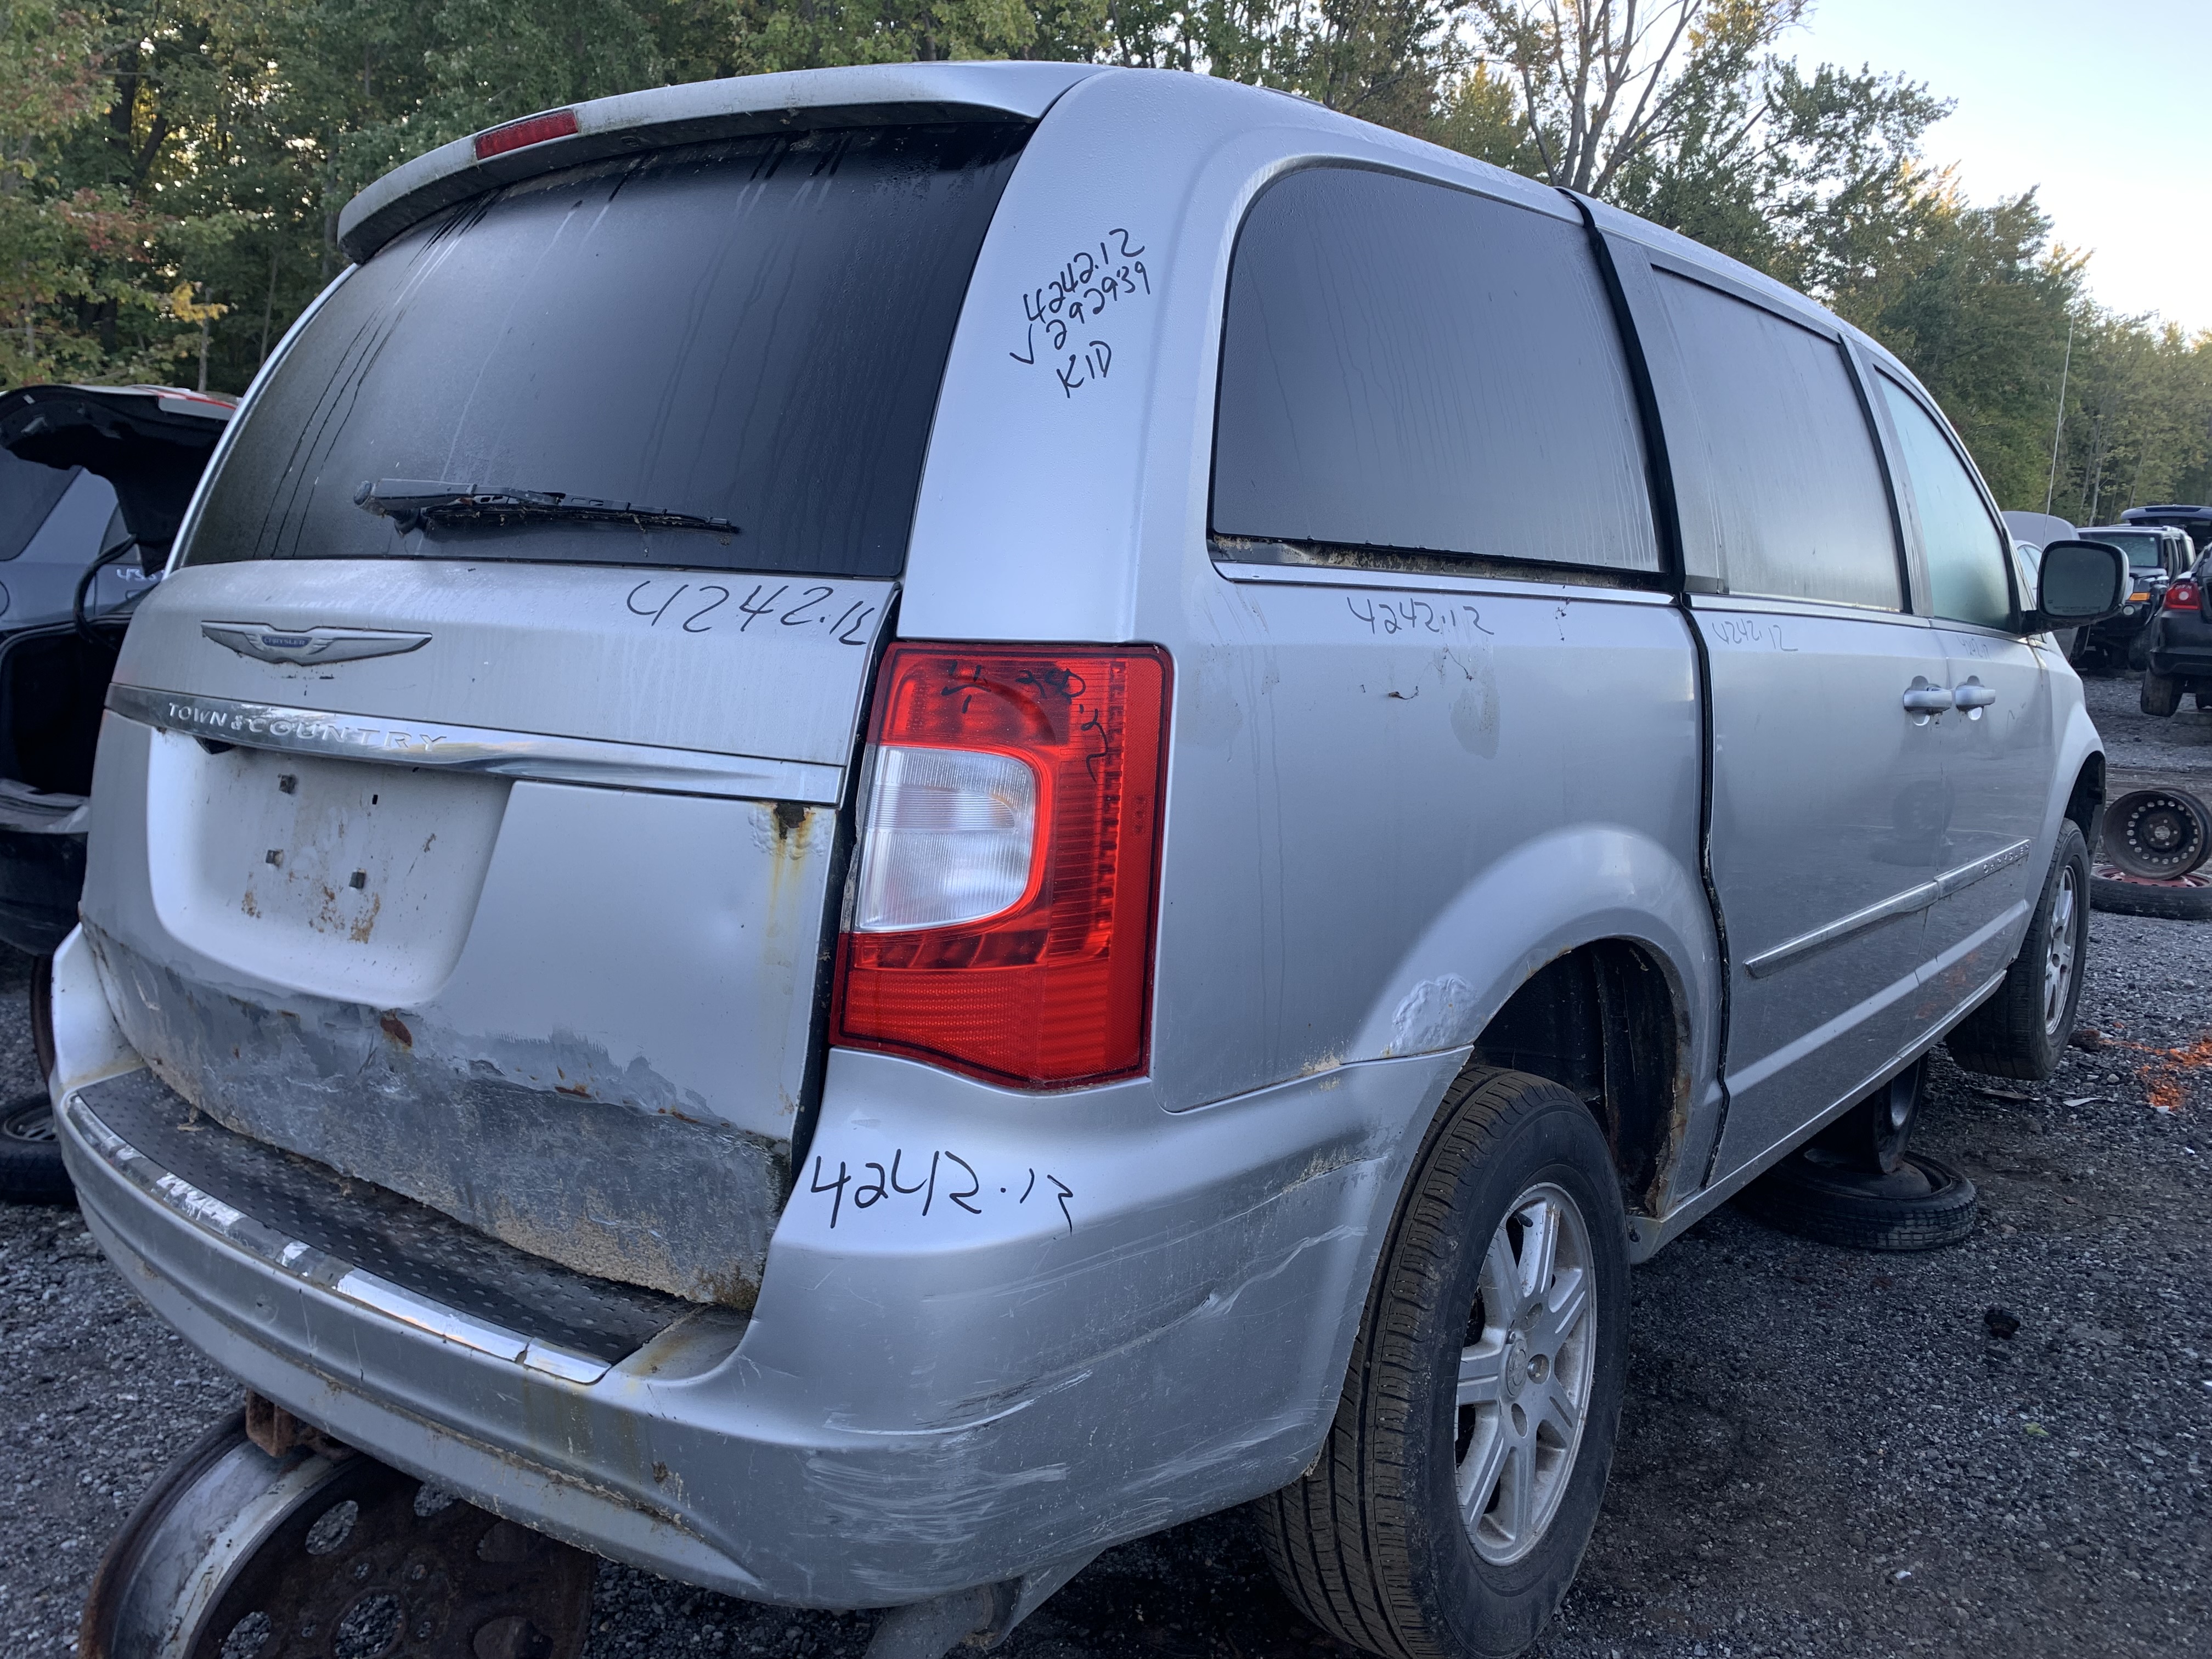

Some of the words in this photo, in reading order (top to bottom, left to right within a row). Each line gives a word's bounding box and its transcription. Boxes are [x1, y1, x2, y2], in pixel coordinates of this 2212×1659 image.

[1023, 228, 1145, 324] 4242.12
[1347, 597, 1495, 635] 4242.12
[169, 702, 228, 727] TOWN
[245, 718, 447, 752] COUNTRY
